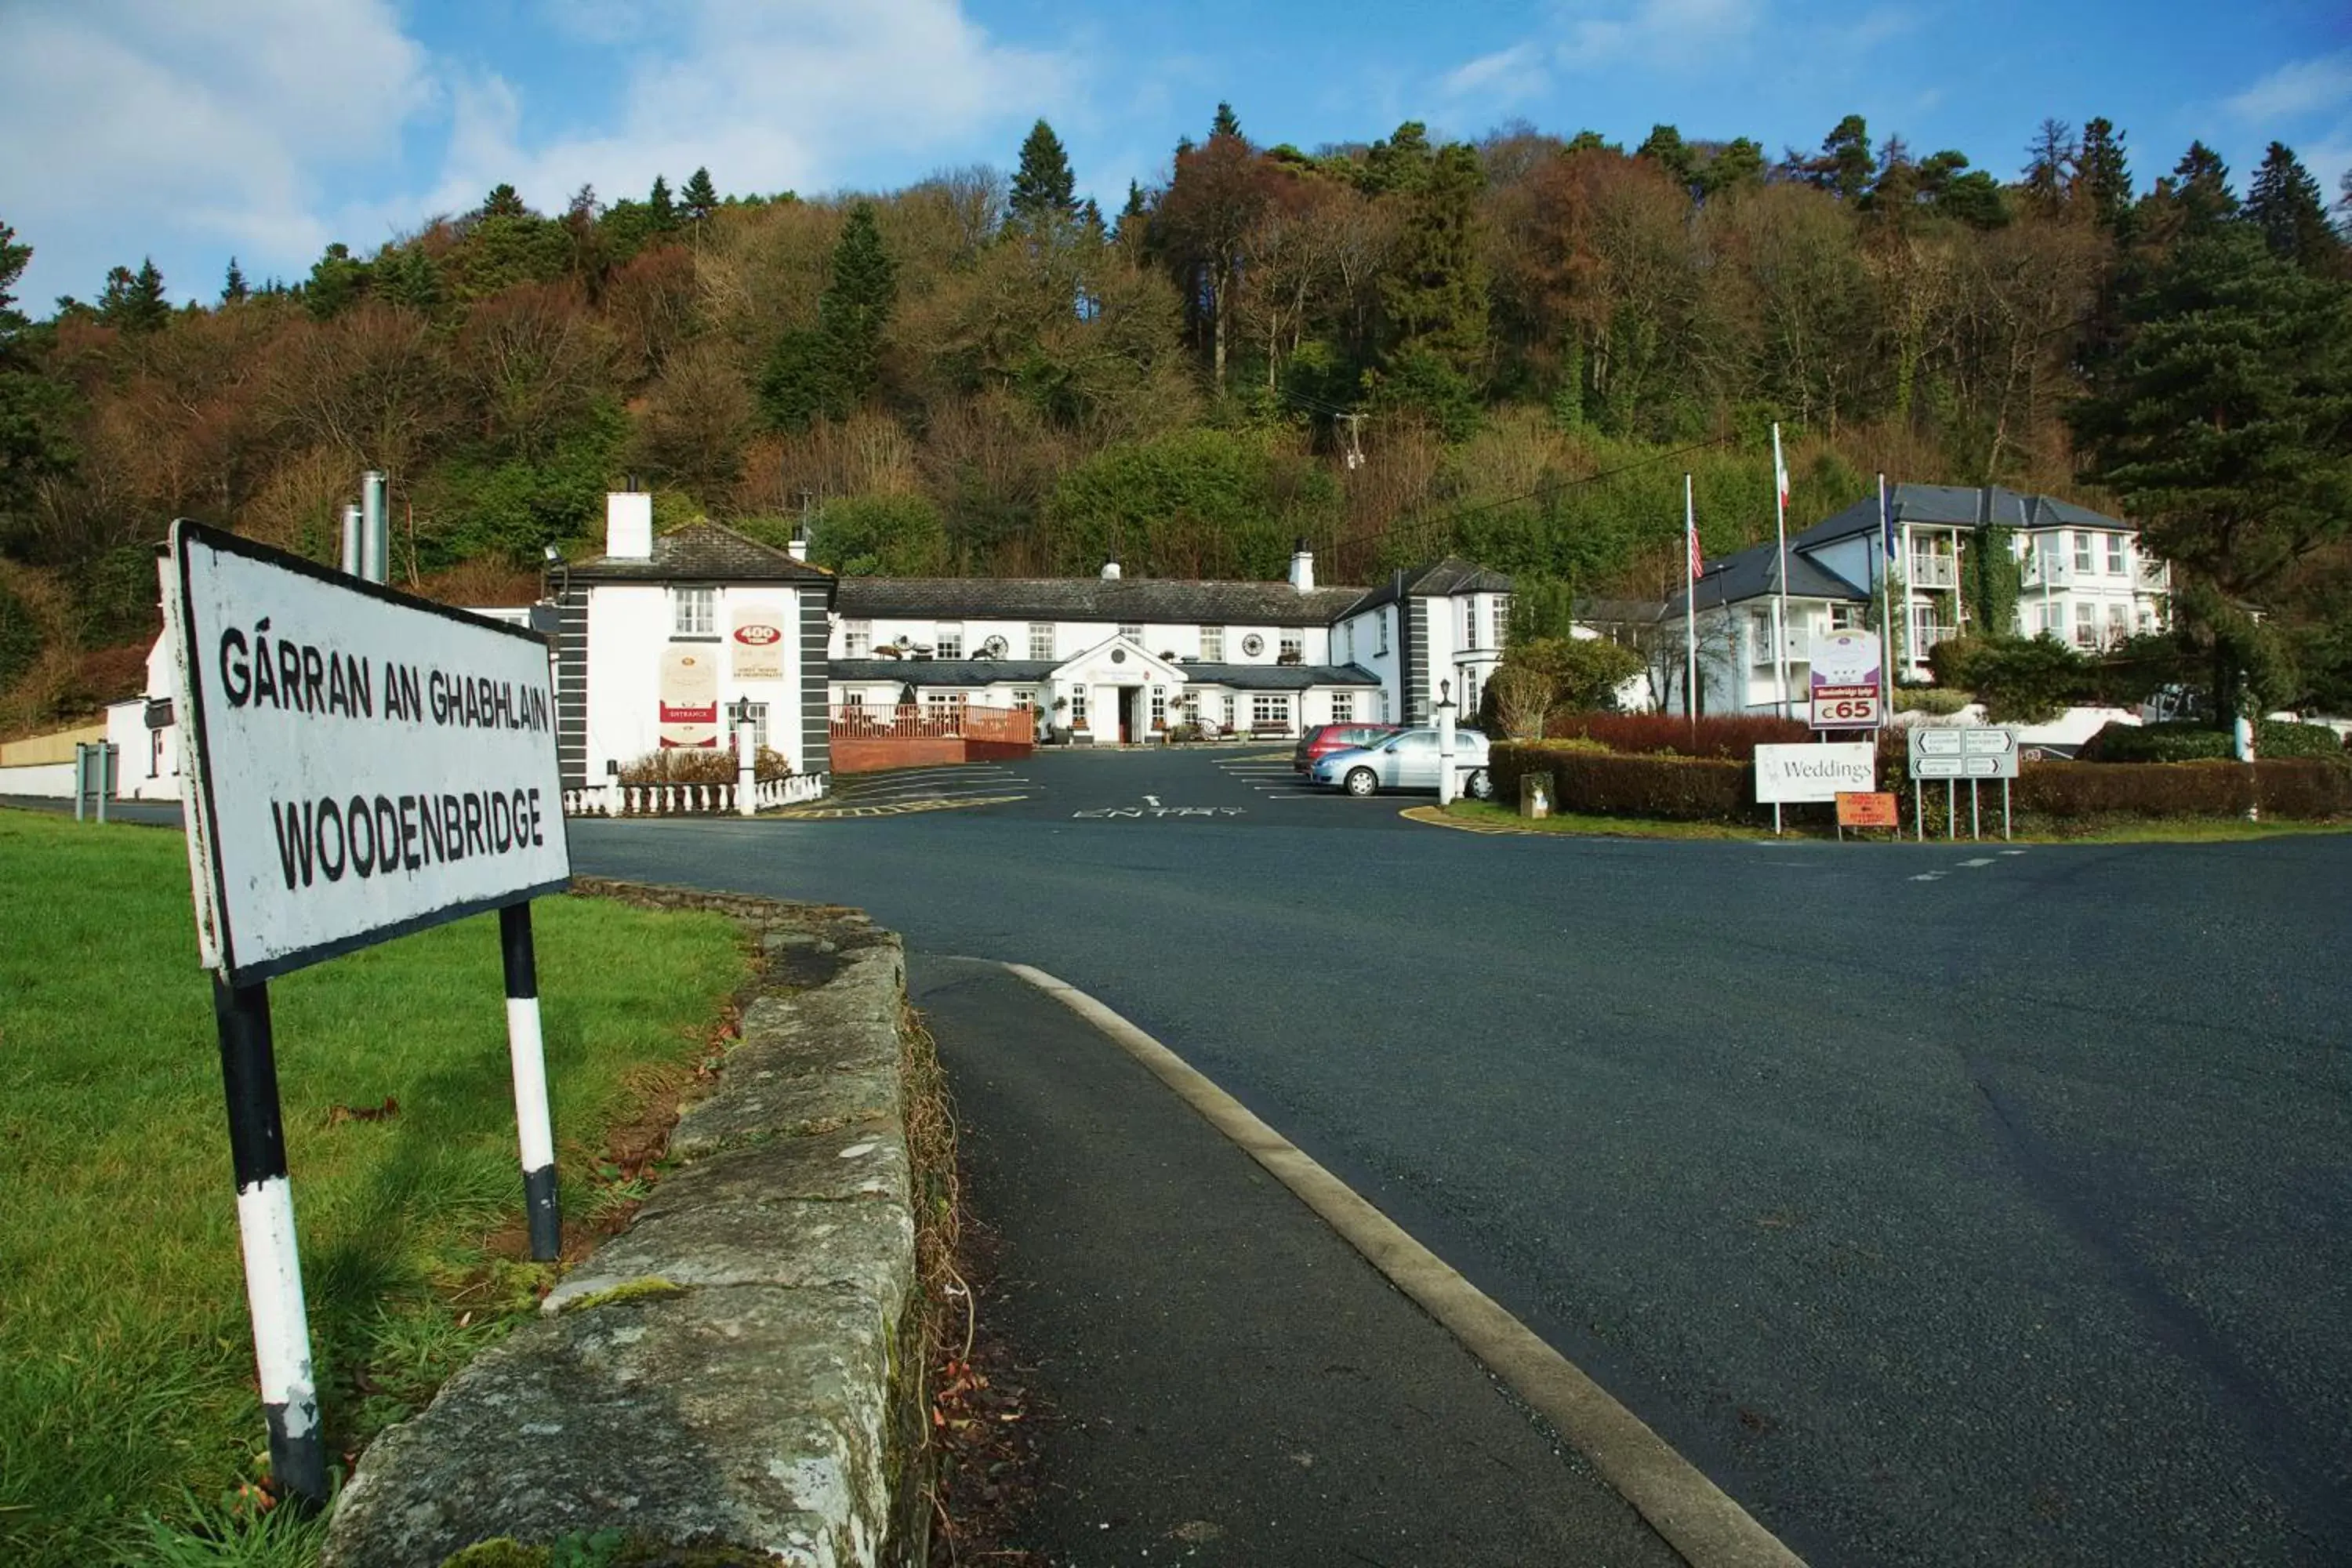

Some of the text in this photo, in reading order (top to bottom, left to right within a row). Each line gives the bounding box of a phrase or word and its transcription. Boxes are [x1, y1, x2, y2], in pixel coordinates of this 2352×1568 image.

[741, 626, 773, 637] 400
[219, 616, 549, 732] GÁRRAN AN GHABHLAIN
[1784, 759, 1872, 783] Weddings
[270, 788, 543, 891] WOODENBRIDGE
